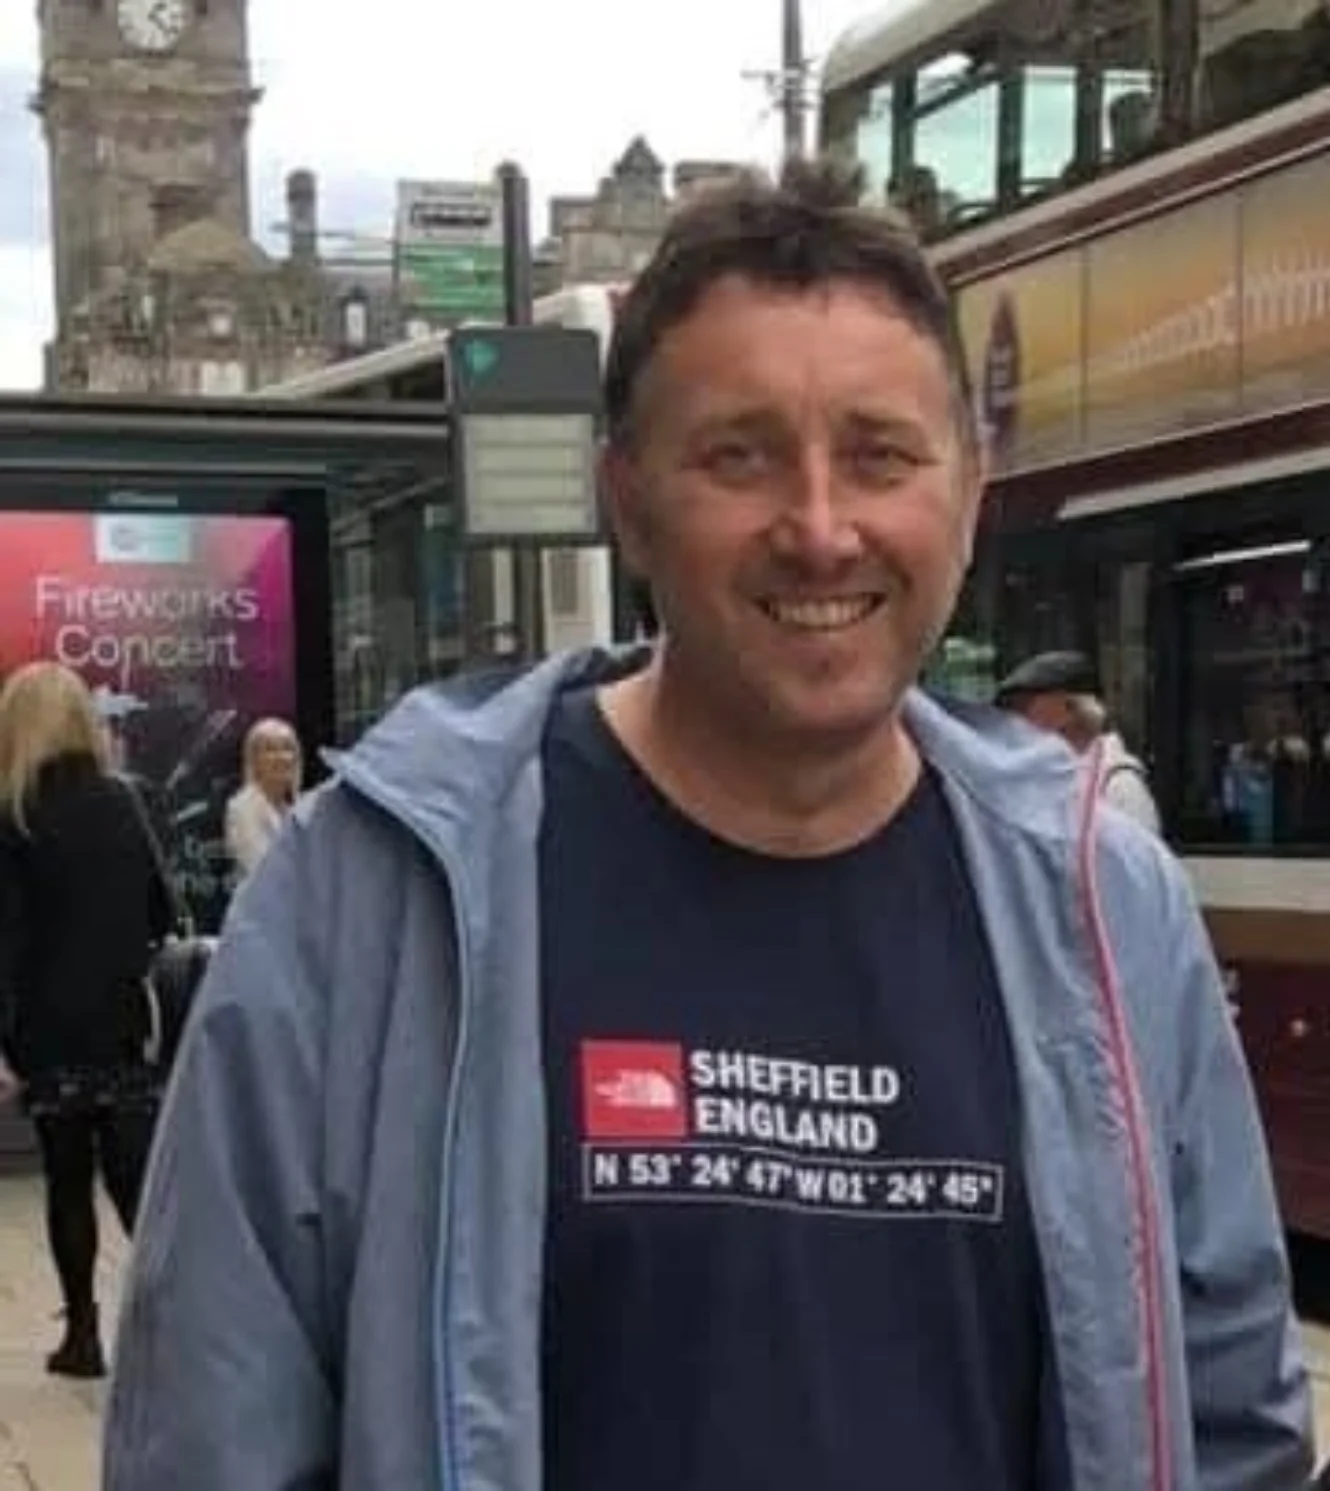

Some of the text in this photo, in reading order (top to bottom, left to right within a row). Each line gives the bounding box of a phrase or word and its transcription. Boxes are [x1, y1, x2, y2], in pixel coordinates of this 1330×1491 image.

[35, 574, 261, 621] Fireworks
[56, 625, 244, 671] Concert
[690, 1050, 900, 1103] SHEFFIELD
[695, 1097, 878, 1151] ENGLAND
[594, 1153, 619, 1186] N
